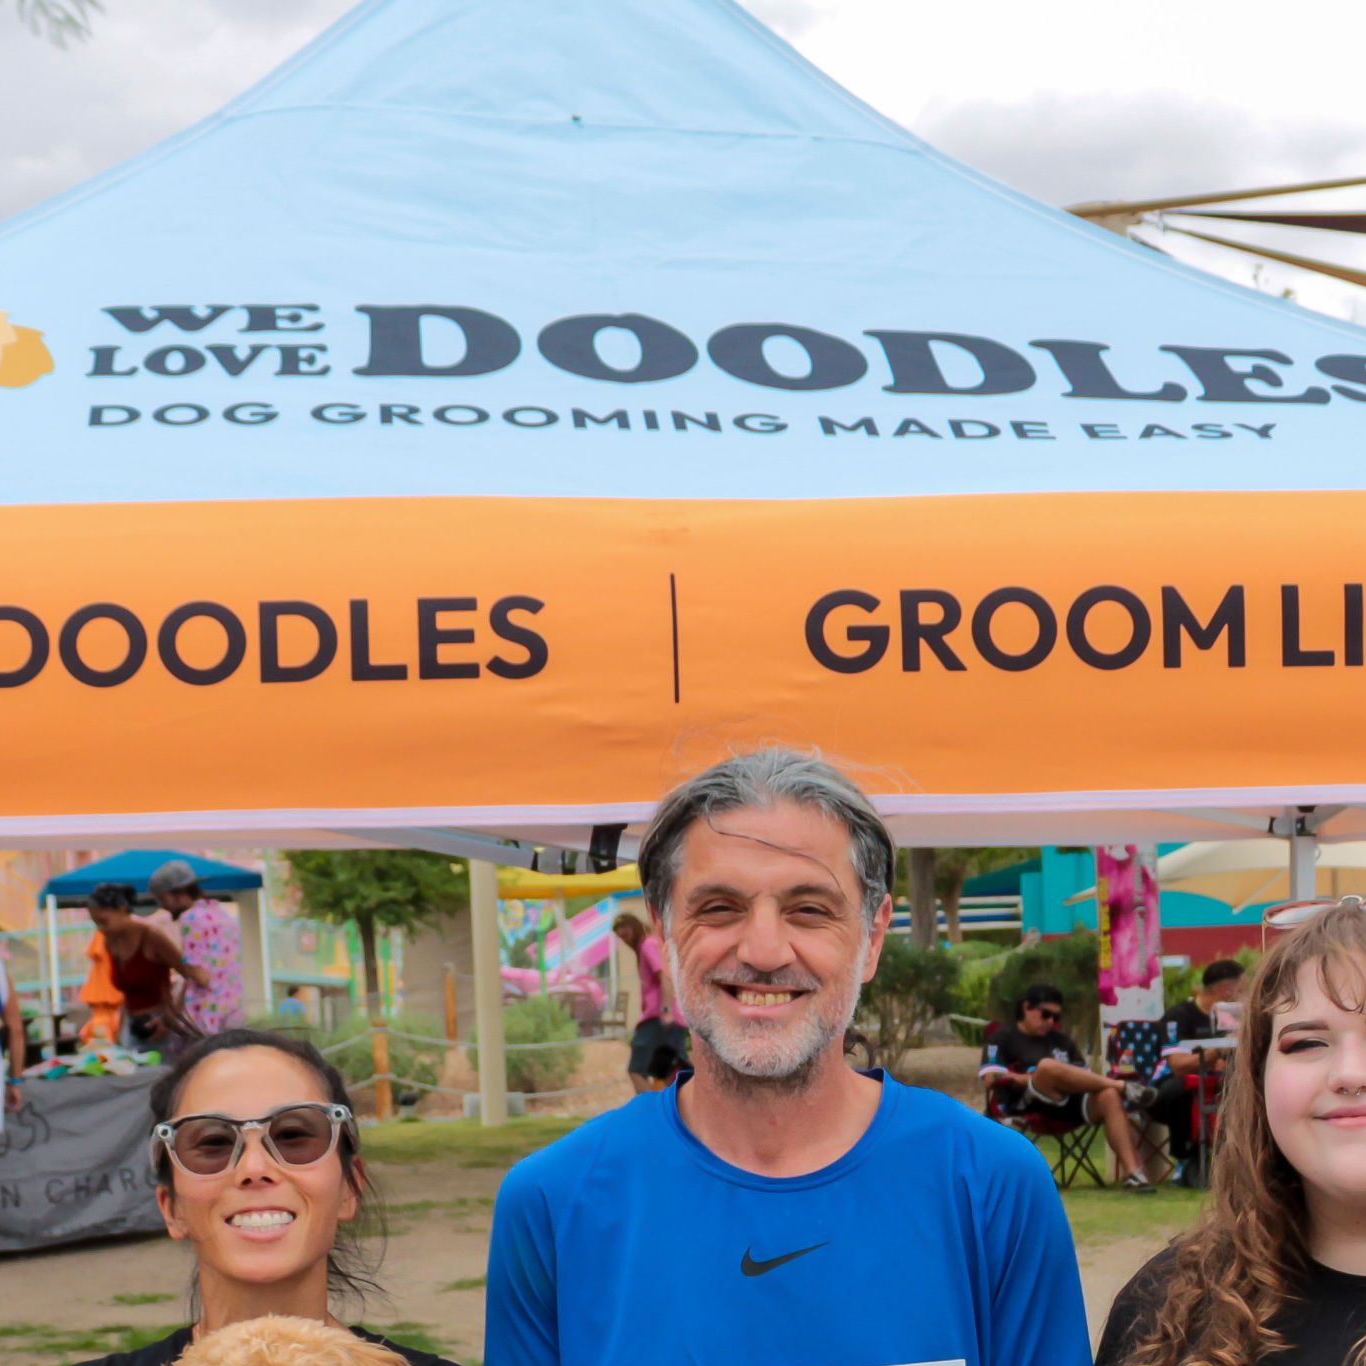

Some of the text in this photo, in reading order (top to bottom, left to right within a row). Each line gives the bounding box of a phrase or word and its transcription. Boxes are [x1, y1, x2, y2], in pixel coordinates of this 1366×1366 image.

[99, 302, 325, 333] WE
[85, 343, 332, 378] LOVE
[88, 402, 1278, 440] DOG GROOMING MADE EASY
[804, 584, 1247, 674] GROOM
